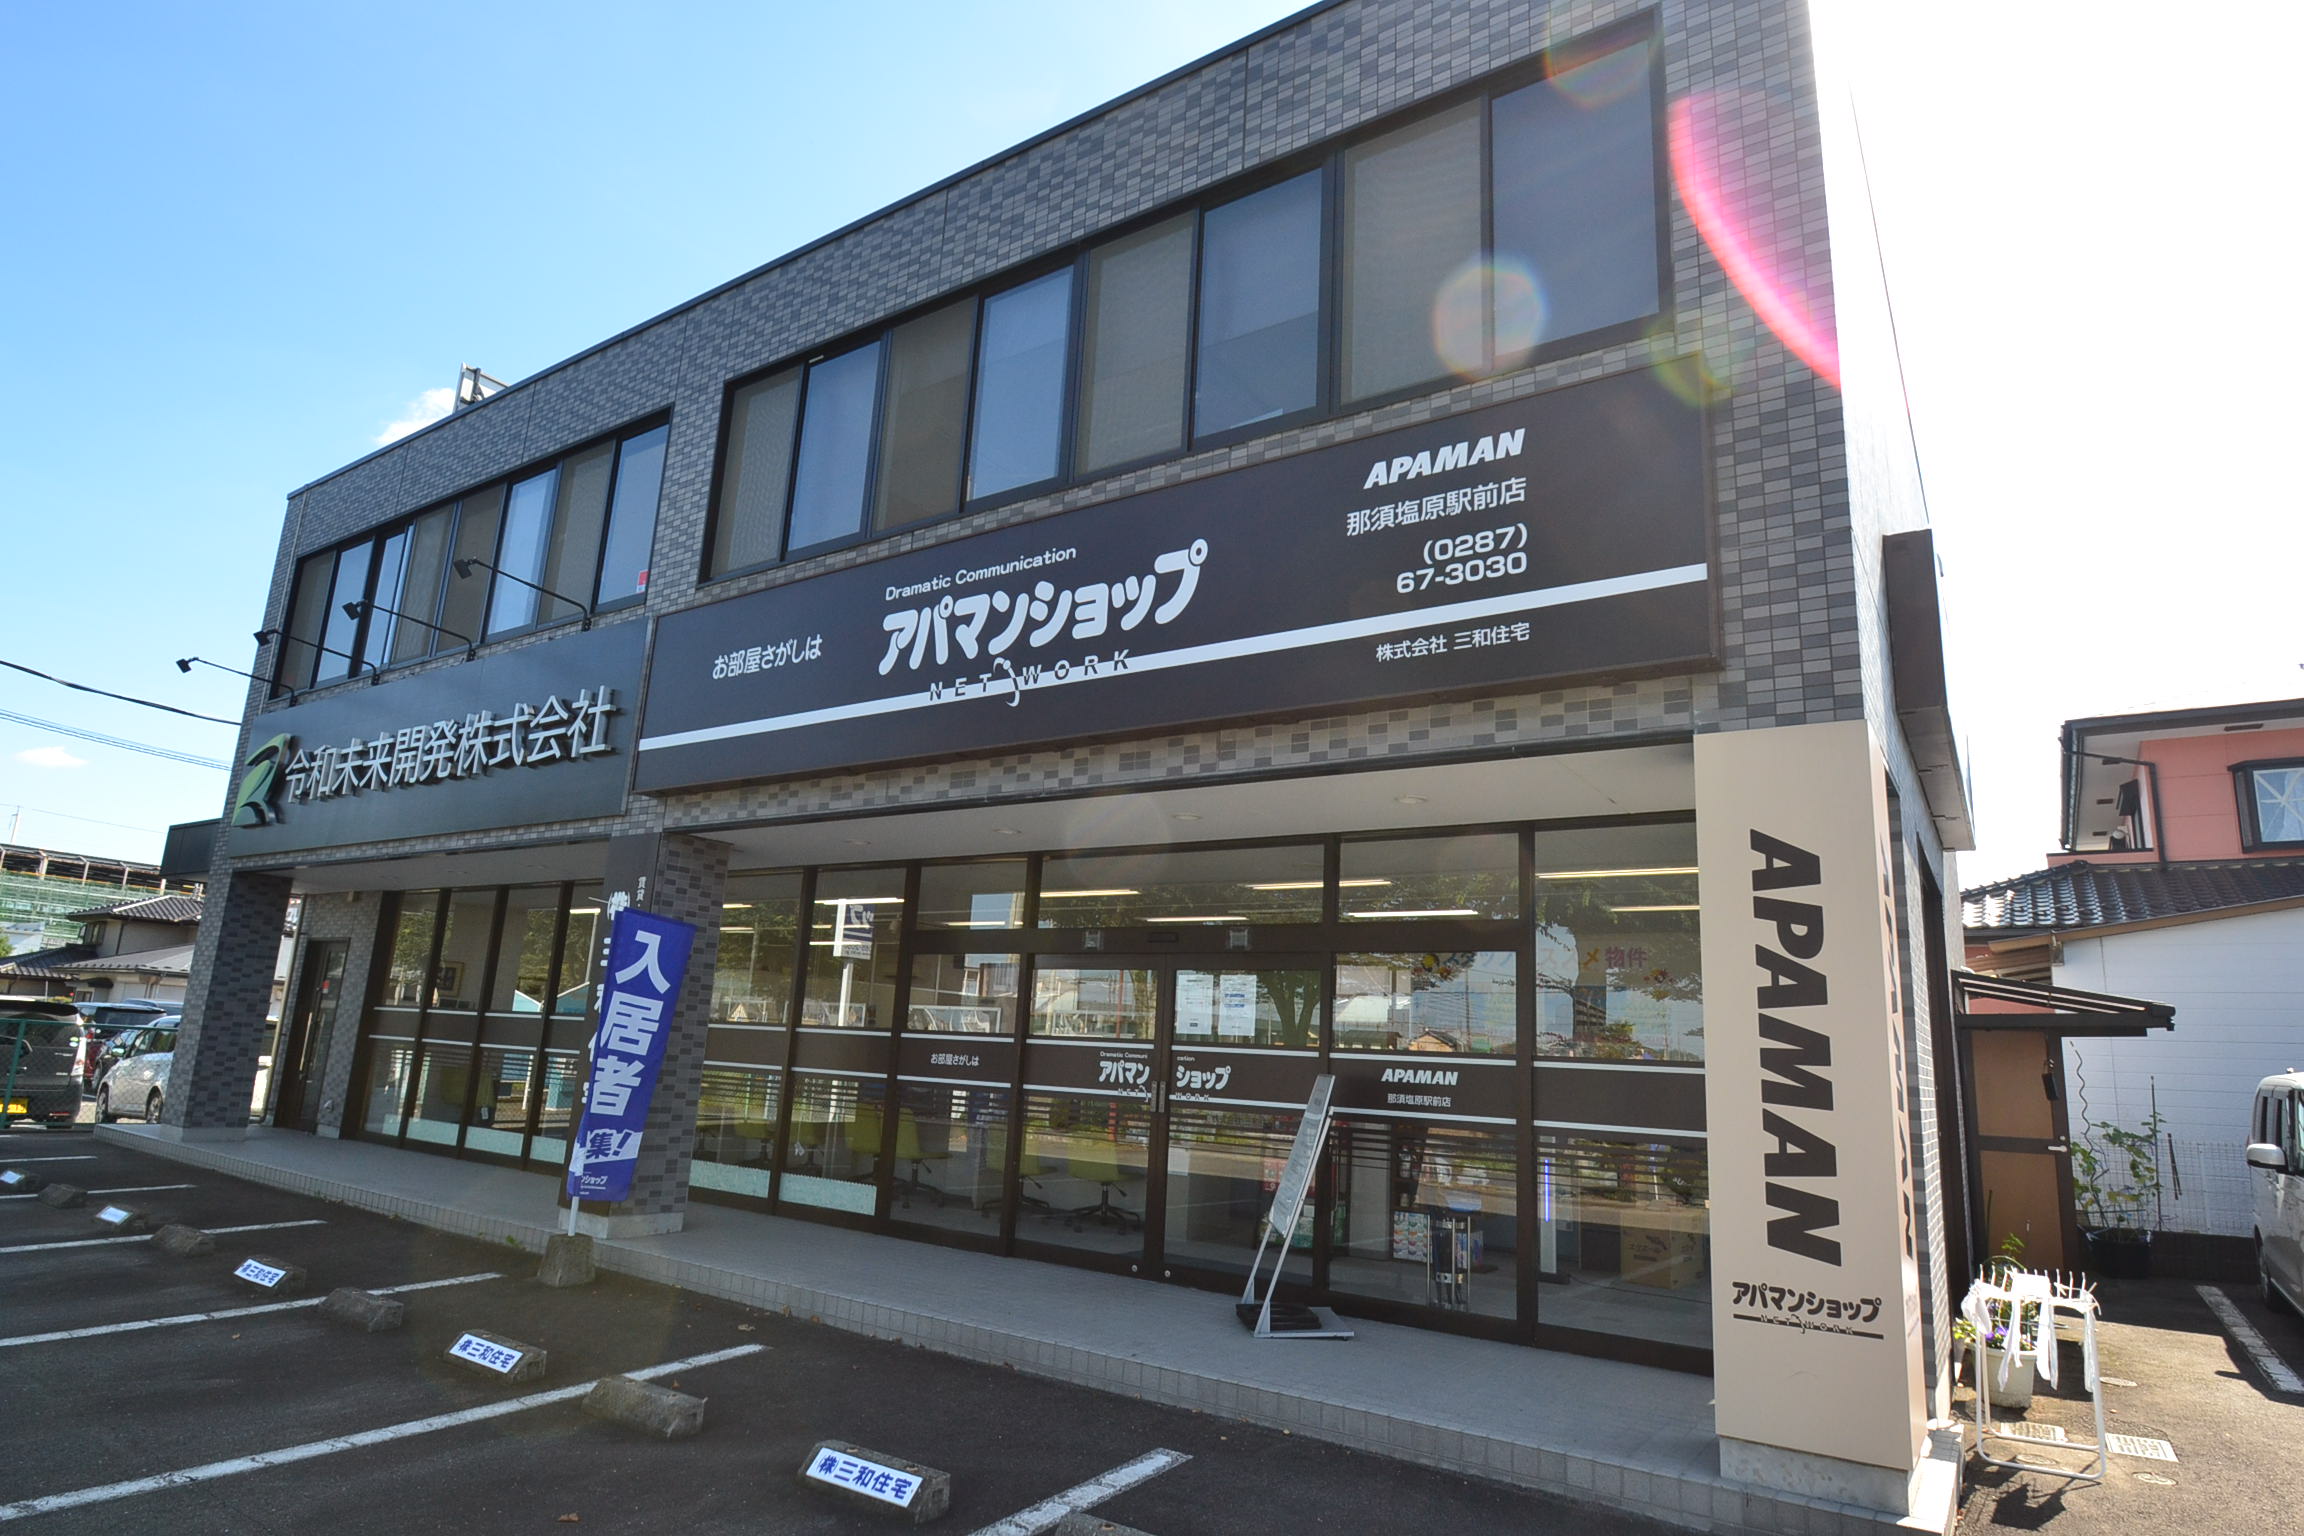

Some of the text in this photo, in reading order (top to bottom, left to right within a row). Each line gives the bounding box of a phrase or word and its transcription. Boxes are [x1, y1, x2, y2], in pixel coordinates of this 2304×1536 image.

[1363, 428, 1526, 489] APAMAN
[1347, 477, 1527, 537] 那須塩原駅前店
[1423, 523, 1528, 564] (0287)
[885, 547, 1077, 601] Dramatic Communication
[1396, 552, 1528, 594] 67-3030
[878, 538, 1209, 676] アパマンショップ
[712, 634, 823, 680] お部屋さがしは
[1376, 622, 1531, 663] 株式会社 三和住宅
[284, 685, 617, 804] 令和未来開発株式会社
[590, 930, 671, 1116] 入居者
[930, 1053, 980, 1067] お部屋さがしは
[1750, 828, 1842, 1267] APAMAN
[1099, 1060, 1151, 1085] アパマン
[1176, 1065, 1232, 1090] ショップ
[1381, 1068, 1459, 1086] APAMAN
[1387, 1093, 1452, 1107] 那須塩原駅前店
[586, 1129, 633, 1160] 集!
[1732, 1281, 1882, 1323] アパマンショップ
